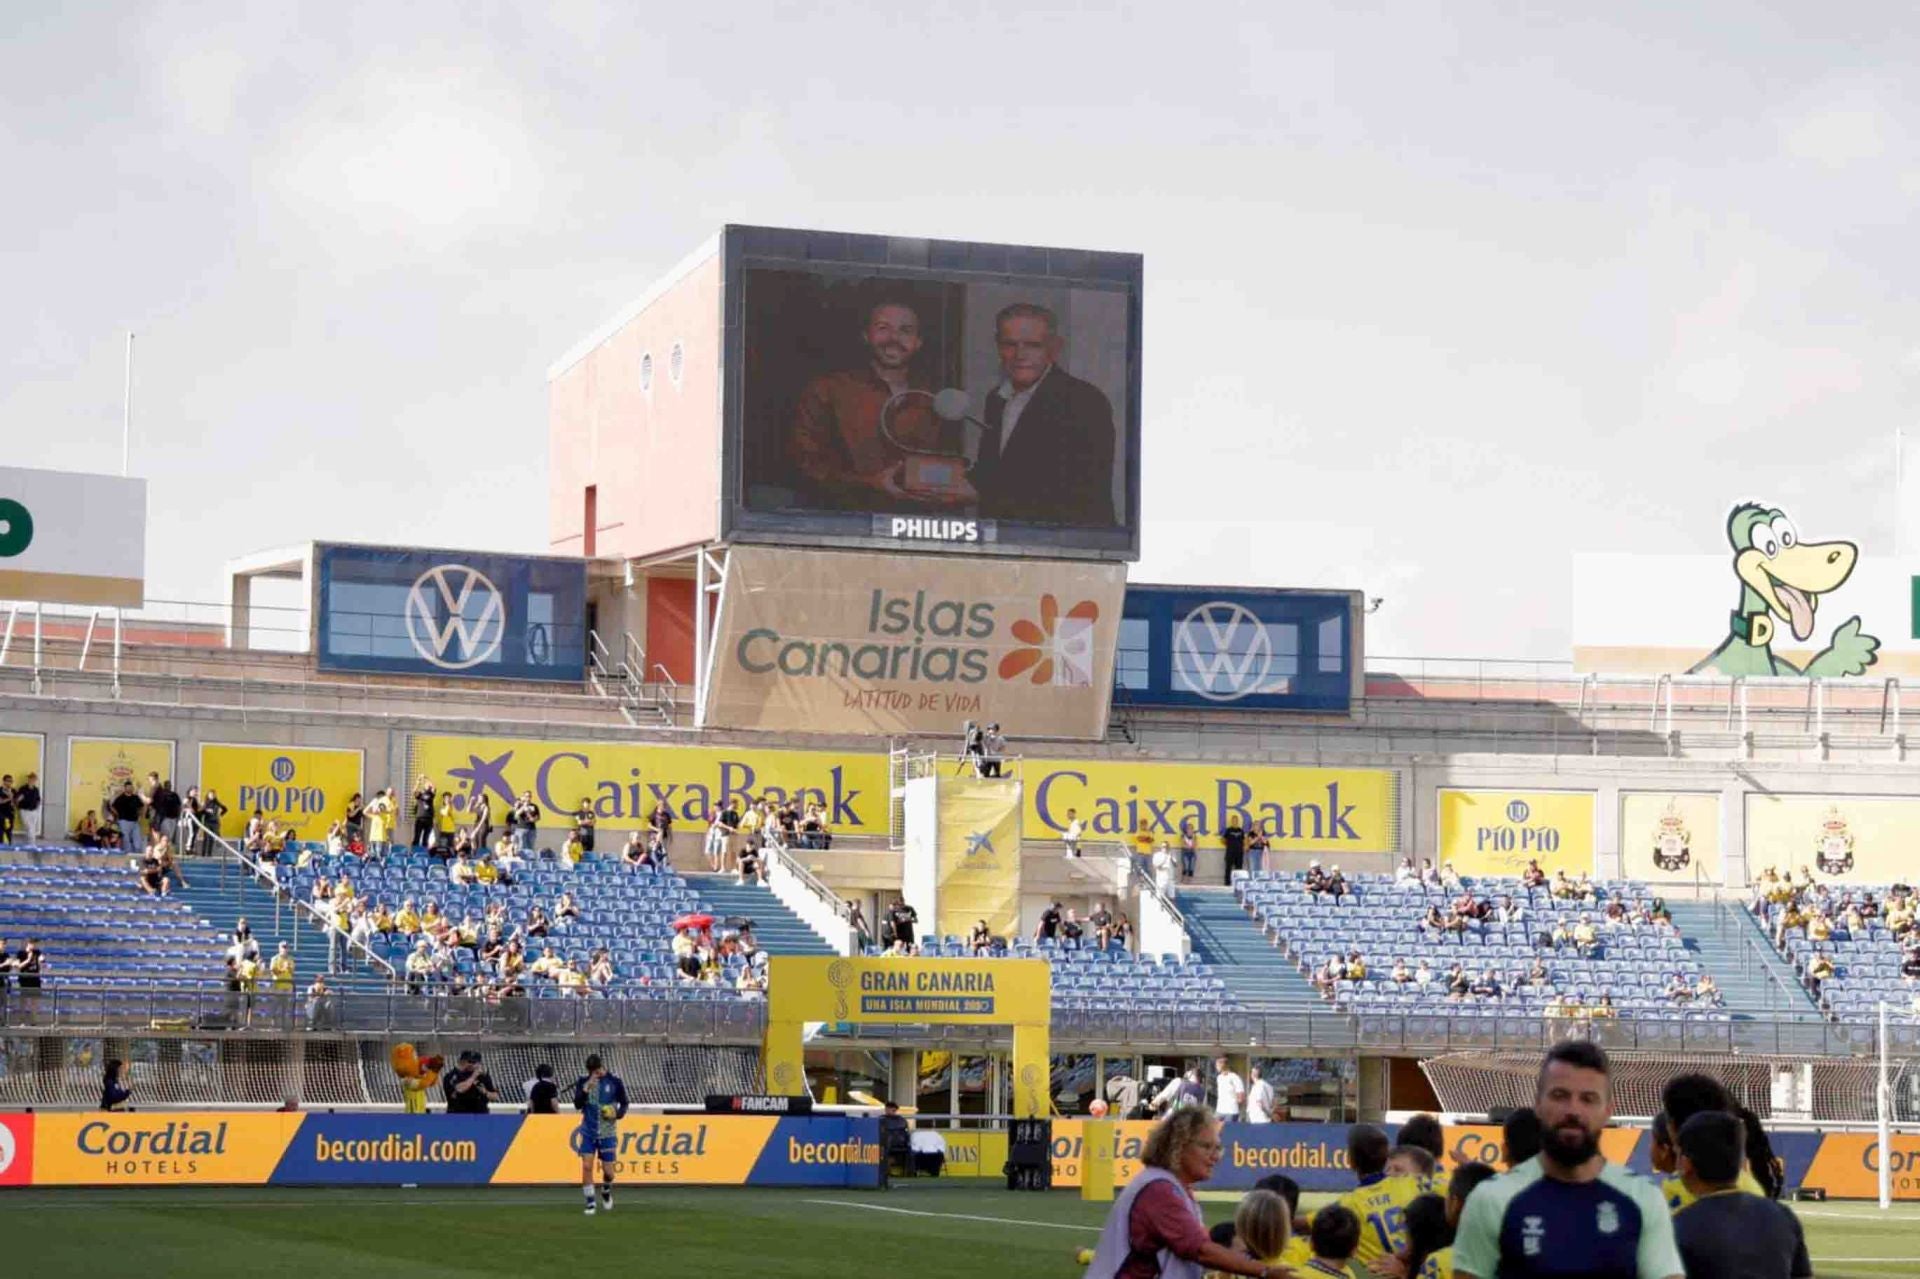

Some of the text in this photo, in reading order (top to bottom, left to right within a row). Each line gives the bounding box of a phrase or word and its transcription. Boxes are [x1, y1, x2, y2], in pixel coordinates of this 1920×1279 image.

[892, 518, 978, 541] PHILIPS
[868, 589, 995, 639] Islas
[737, 628, 989, 683] Canarias
[843, 689, 981, 712] LATITUD DE VIDA
[1034, 771, 1361, 840] CaixaBank
[860, 971, 995, 992] GRAN CANARIA
[865, 998, 887, 1011] UNA
[890, 999, 912, 1011] ISLA
[915, 999, 960, 1012] MUNDIAL
[77, 1121, 228, 1155] Cordial
[316, 1133, 476, 1162] becordial.com
[107, 1160, 197, 1174] HOTELS
